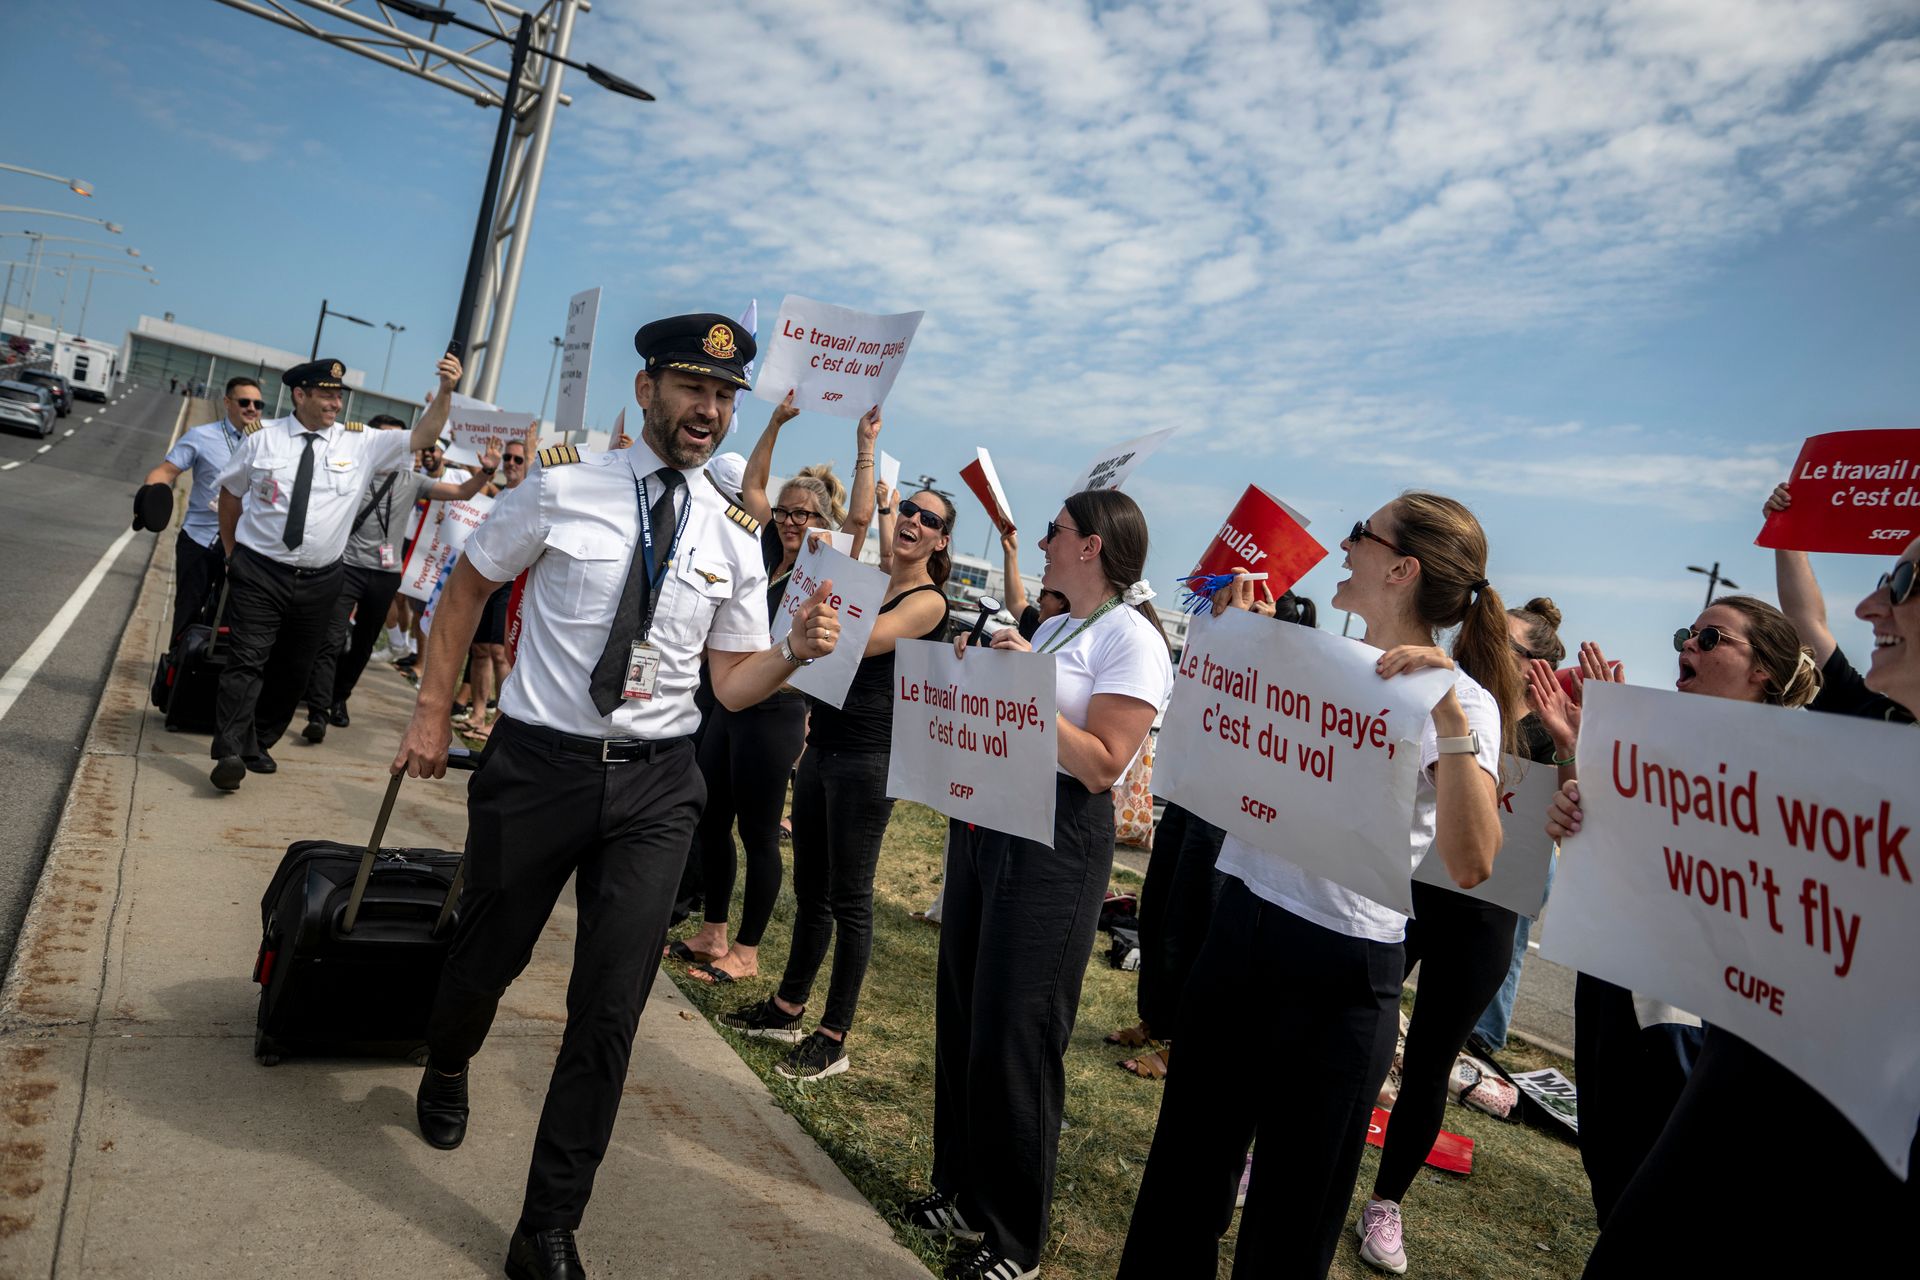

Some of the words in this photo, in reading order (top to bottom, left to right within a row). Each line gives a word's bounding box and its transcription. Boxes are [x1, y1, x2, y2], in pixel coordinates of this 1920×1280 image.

[783, 320, 804, 340] Le
[810, 328, 856, 352] travail
[856, 340, 880, 355] non
[810, 353, 844, 372] c'est
[845, 359, 862, 375] du
[864, 361, 884, 377] vol
[822, 392, 843, 401] SCFP
[452, 421, 463, 431] Le
[465, 422, 490, 433] travail
[493, 425, 508, 434] non
[1800, 461, 1828, 480] Le
[1832, 460, 1909, 480] travail
[1831, 486, 1891, 506] c'est
[1868, 529, 1911, 540] SCFP
[413, 553, 437, 590] Poverty
[792, 564, 803, 585] de
[801, 576, 842, 611] misre
[1083, 604, 1111, 628] Contract
[901, 676, 919, 702] Le
[924, 680, 958, 711] travail
[961, 693, 989, 718] non
[996, 697, 1045, 733] payé,
[1179, 643, 1198, 679] Le
[1201, 653, 1258, 704] travail
[1266, 683, 1311, 723] non
[1321, 701, 1395, 760] payé,
[929, 715, 953, 747] c'est
[958, 723, 977, 752] du
[983, 731, 1008, 758] vol
[1203, 703, 1251, 749] c'est
[1258, 723, 1288, 764] du
[1298, 745, 1334, 782] vol
[950, 782, 974, 800] SCFP
[1241, 795, 1277, 823] SCFP
[1612, 740, 1759, 836] Unpaid
[1777, 795, 1912, 884] work
[1663, 846, 1783, 934] won't
[1799, 877, 1861, 978] fly
[1724, 965, 1785, 1016] CUPE
